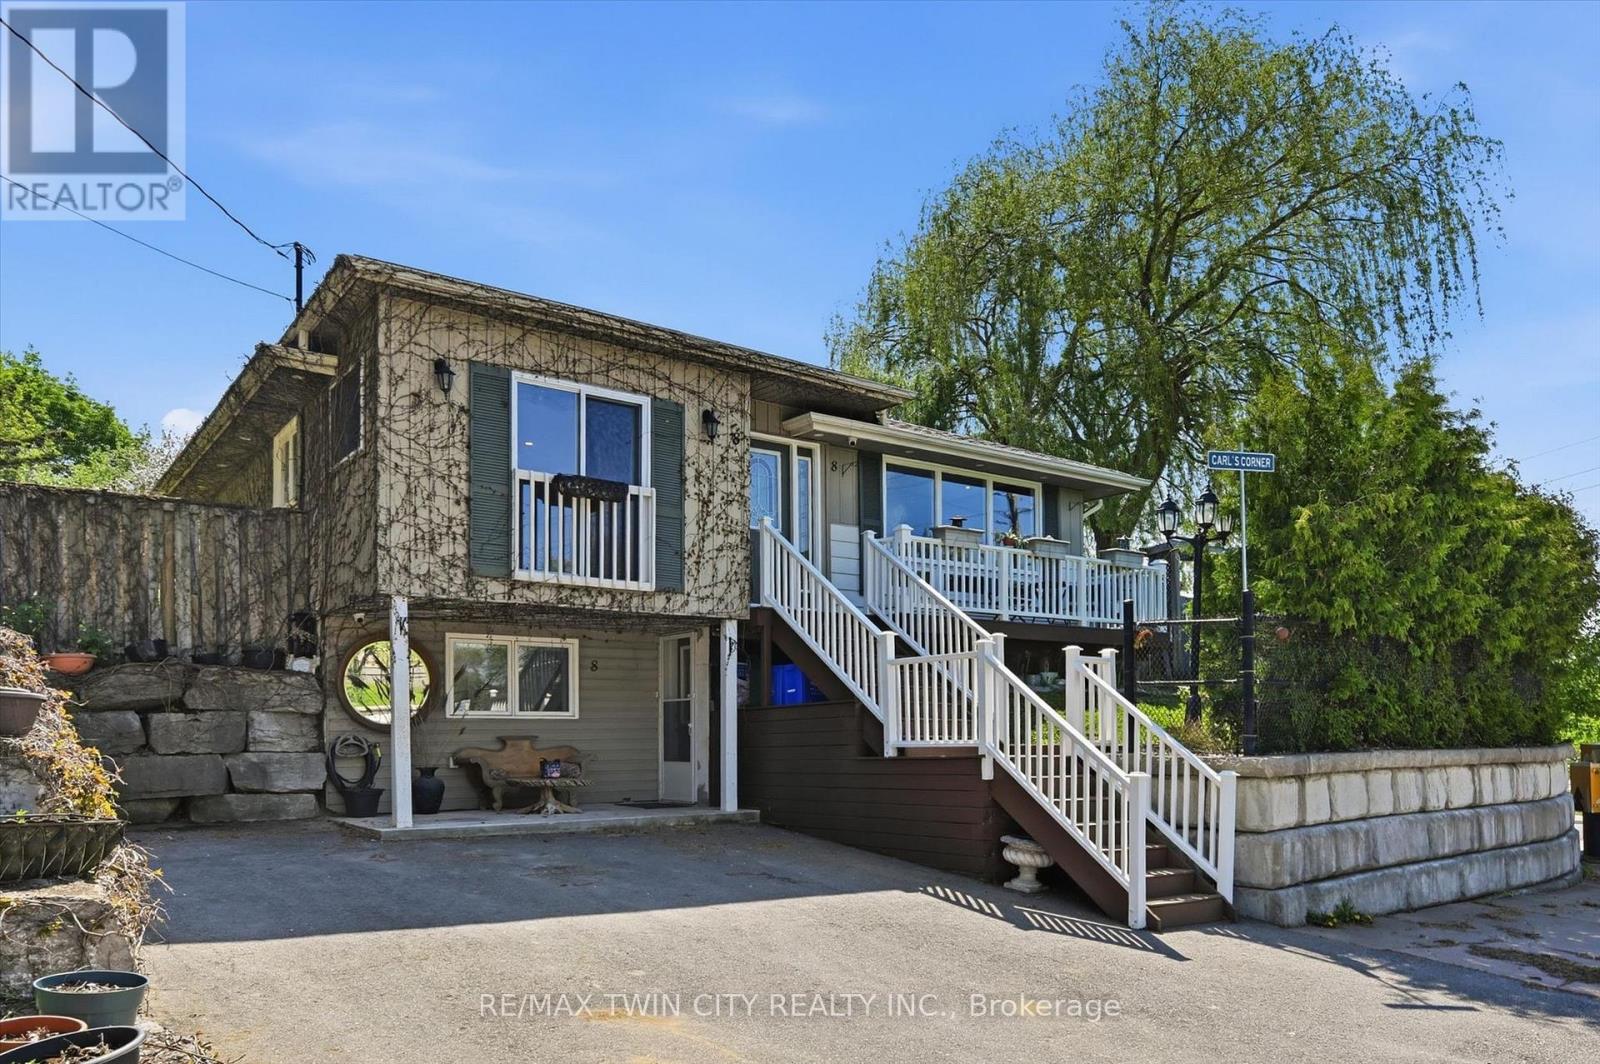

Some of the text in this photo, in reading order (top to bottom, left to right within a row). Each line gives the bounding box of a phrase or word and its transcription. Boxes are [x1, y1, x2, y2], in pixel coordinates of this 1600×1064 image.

[830, 460, 838, 472] 8
[1211, 454, 1271, 468] CARL'S CORNER
[590, 659, 598, 672] 8
